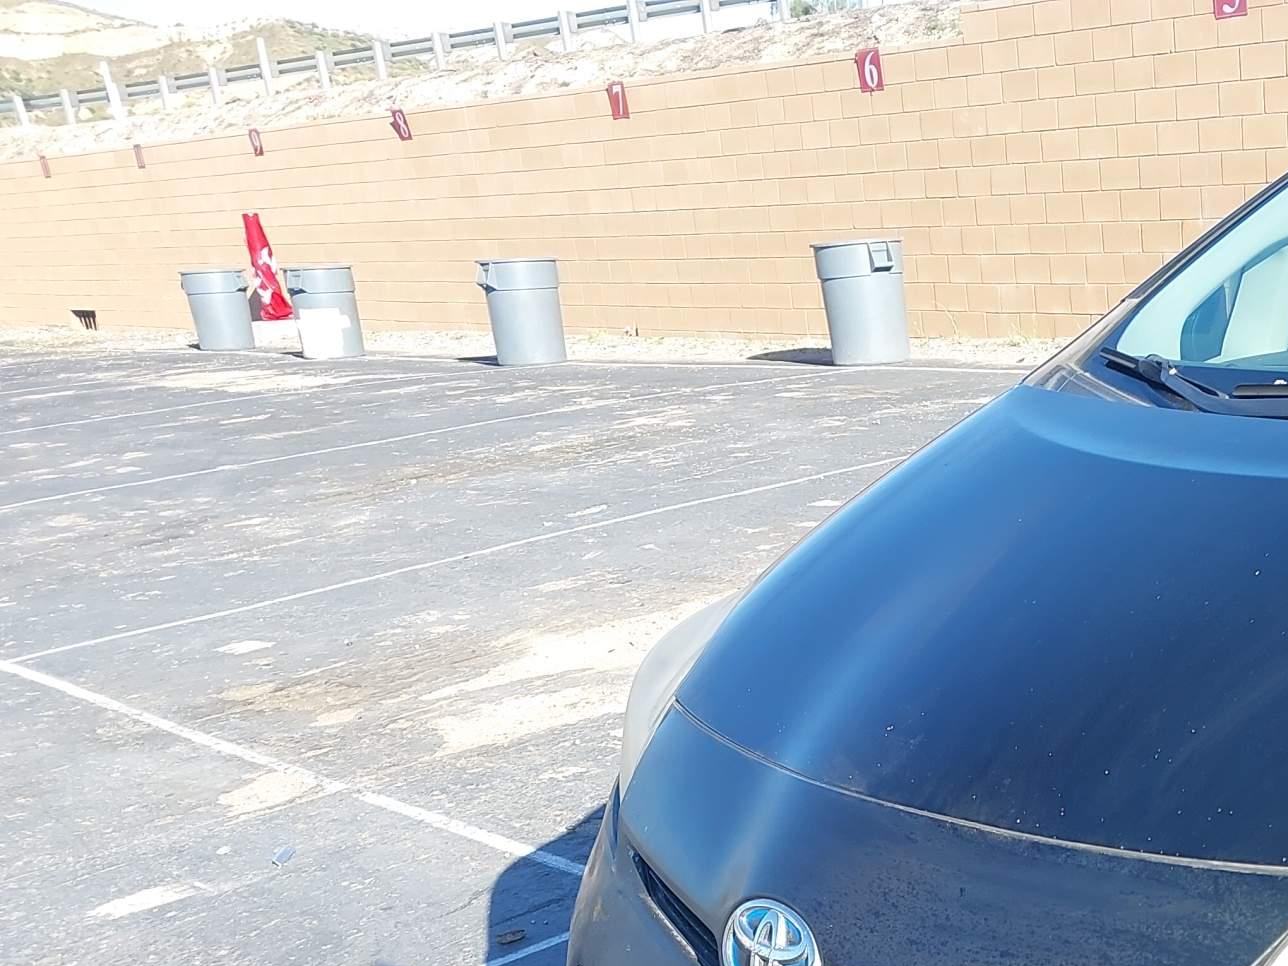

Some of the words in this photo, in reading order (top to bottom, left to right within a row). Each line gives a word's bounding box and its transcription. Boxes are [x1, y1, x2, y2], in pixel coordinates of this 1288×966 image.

[864, 51, 879, 89] 6
[612, 84, 624, 116] 7
[395, 112, 409, 138] 8
